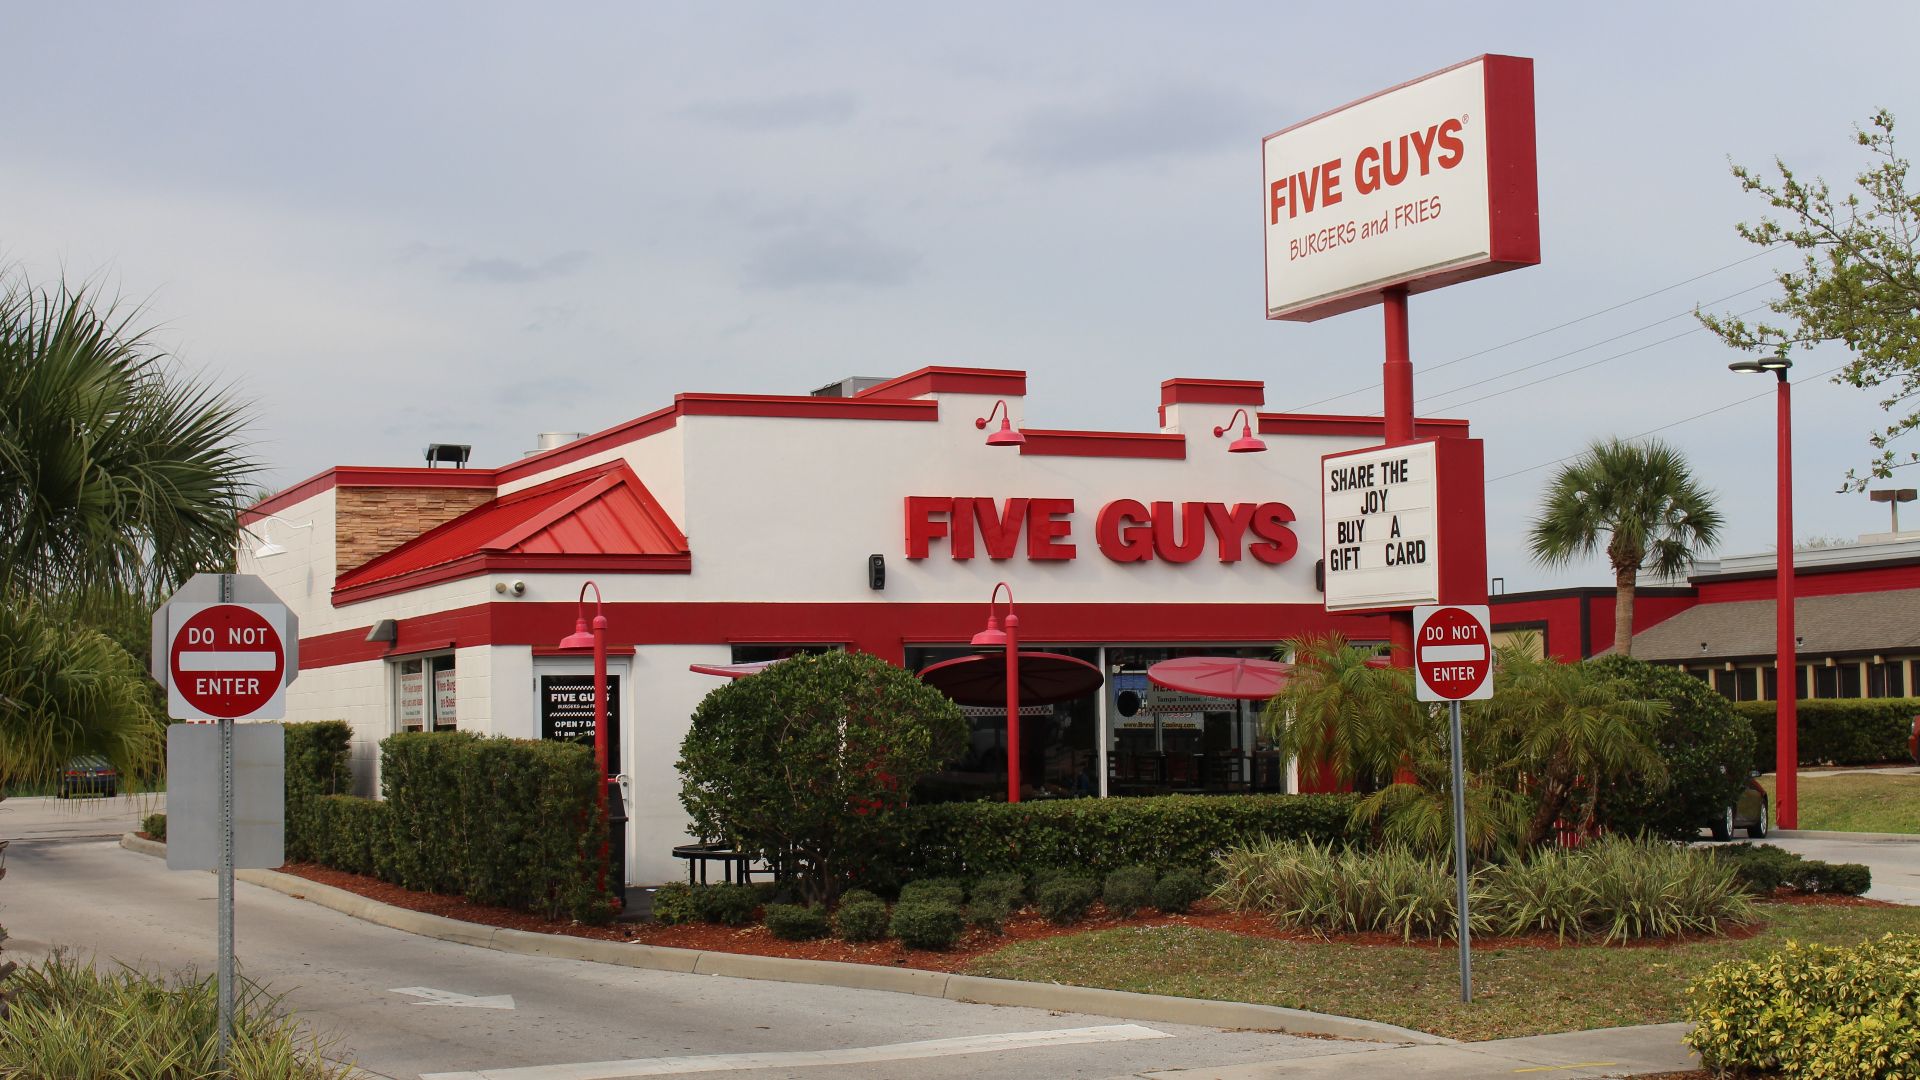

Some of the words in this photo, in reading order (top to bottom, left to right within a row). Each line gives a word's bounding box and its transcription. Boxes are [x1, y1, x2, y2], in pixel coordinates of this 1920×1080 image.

[1271, 158, 1342, 225] FIVE
[1290, 220, 1356, 261] BURGERS
[1361, 210, 1389, 239] and
[1394, 195, 1442, 229] FRIES
[1331, 464, 1374, 492] SHARE
[1381, 459, 1408, 485] THE
[1360, 489, 1388, 515] JOY
[904, 496, 1077, 560] FIVE
[1095, 498, 1298, 564] GUYS
[1337, 519, 1365, 544] BUY
[1390, 515, 1401, 539] A
[1330, 546, 1361, 571] GIFT
[1385, 540, 1426, 566] CARD
[188, 627, 215, 645] DO
[228, 627, 268, 645] NOT
[1426, 626, 1444, 640] DO
[1452, 625, 1478, 640] NOT
[196, 678, 260, 695] ENTER
[1433, 666, 1475, 682] ENTER
